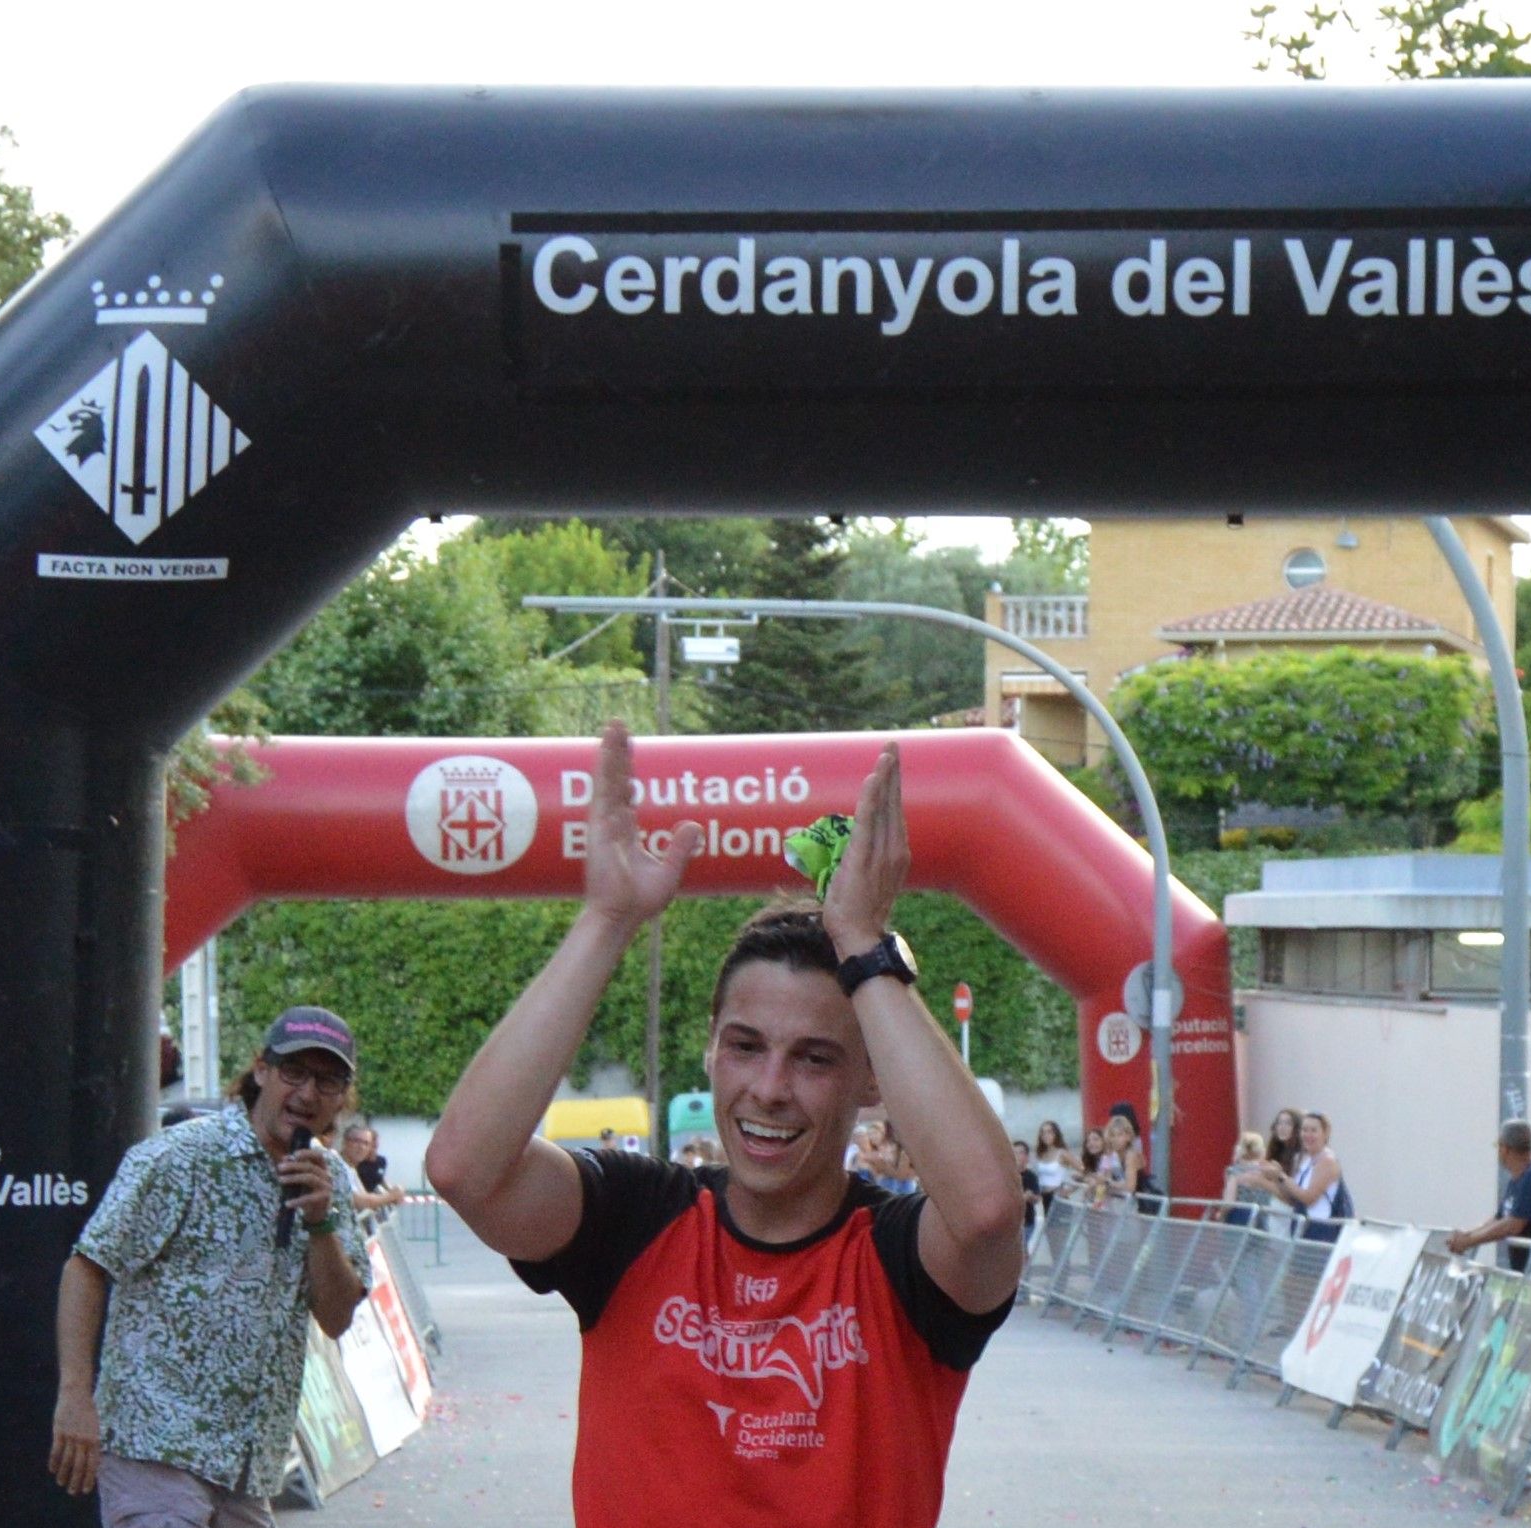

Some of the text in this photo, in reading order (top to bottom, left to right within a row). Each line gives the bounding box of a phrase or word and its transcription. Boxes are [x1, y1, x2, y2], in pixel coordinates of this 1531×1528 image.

[532, 235, 1080, 337] Cerdanyola
[1112, 237, 1252, 317] del
[51, 560, 218, 577] FACTA NON VERBA
[740, 1411, 817, 1430] Catalana
[738, 1428, 826, 1448] Occidente
[734, 1444, 779, 1461] Seguros
